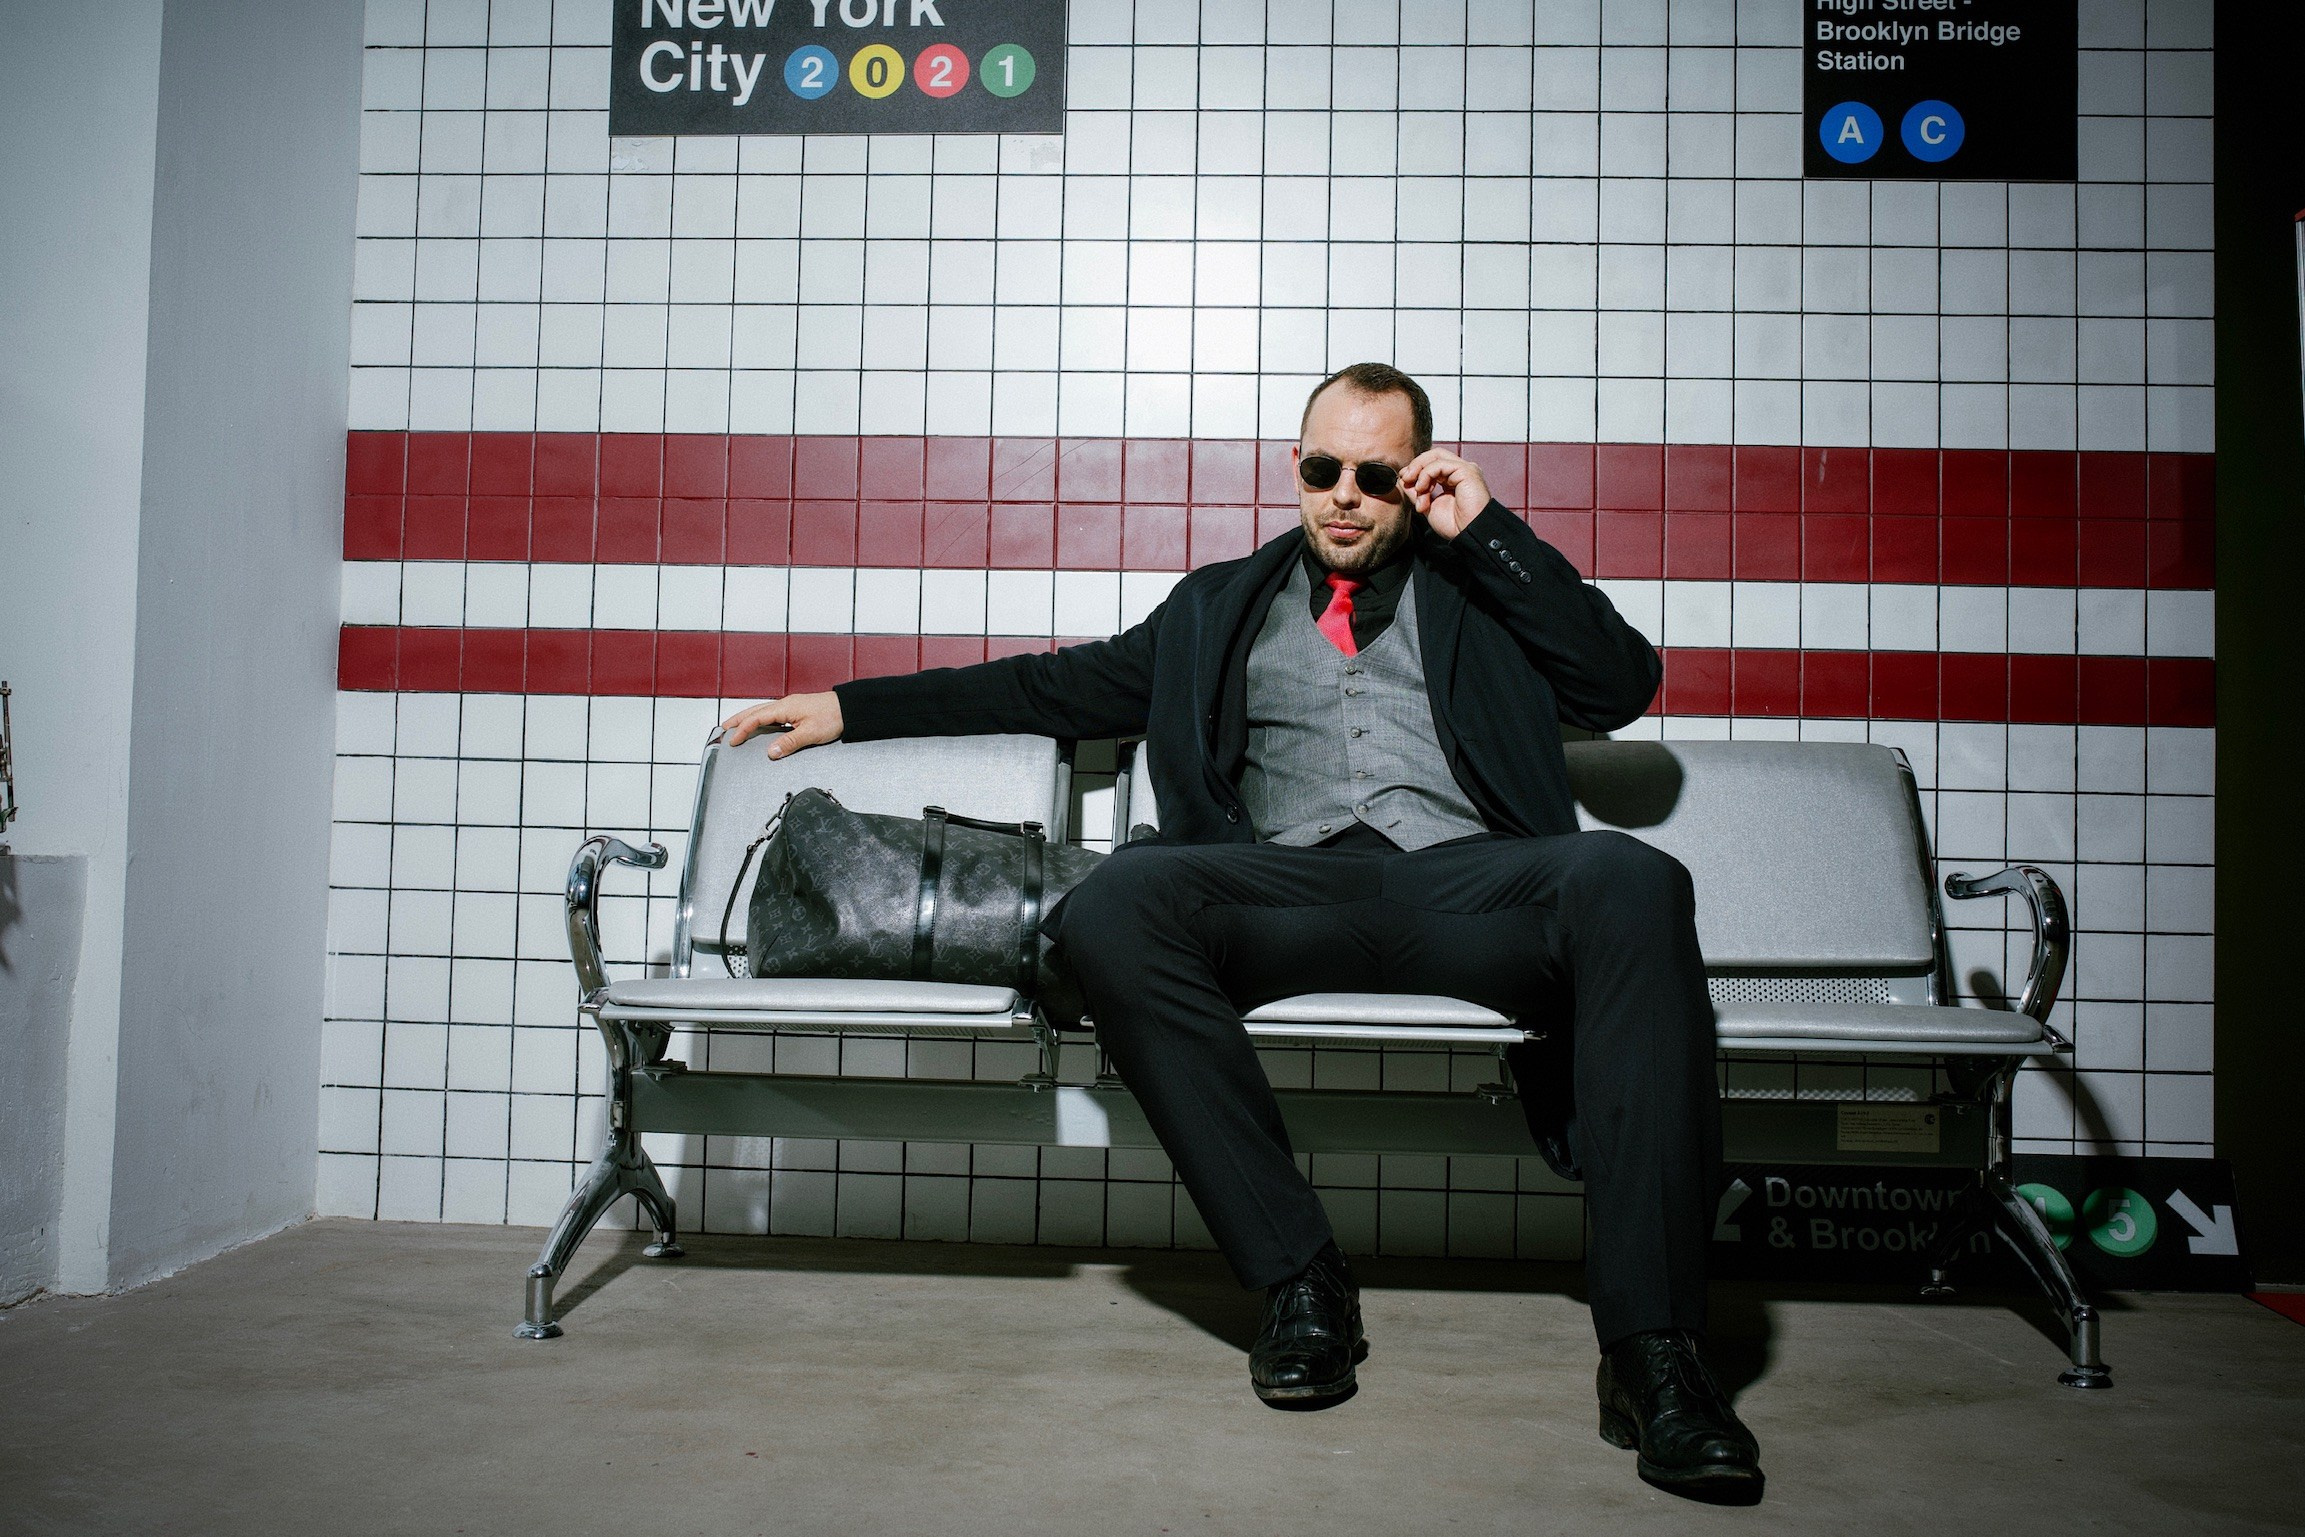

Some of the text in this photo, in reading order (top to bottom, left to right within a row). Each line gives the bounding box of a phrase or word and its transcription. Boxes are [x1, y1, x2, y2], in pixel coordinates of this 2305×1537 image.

[641, 0, 946, 28] New York
[1817, 20, 2021, 46] Brooklyn Bridge
[640, 40, 1014, 106] City 2 0 2 1
[1817, 50, 1905, 71] Station
[1837, 116, 1946, 145] A C
[1767, 1216, 1797, 1249] &
[2107, 1198, 2137, 1242] 5
